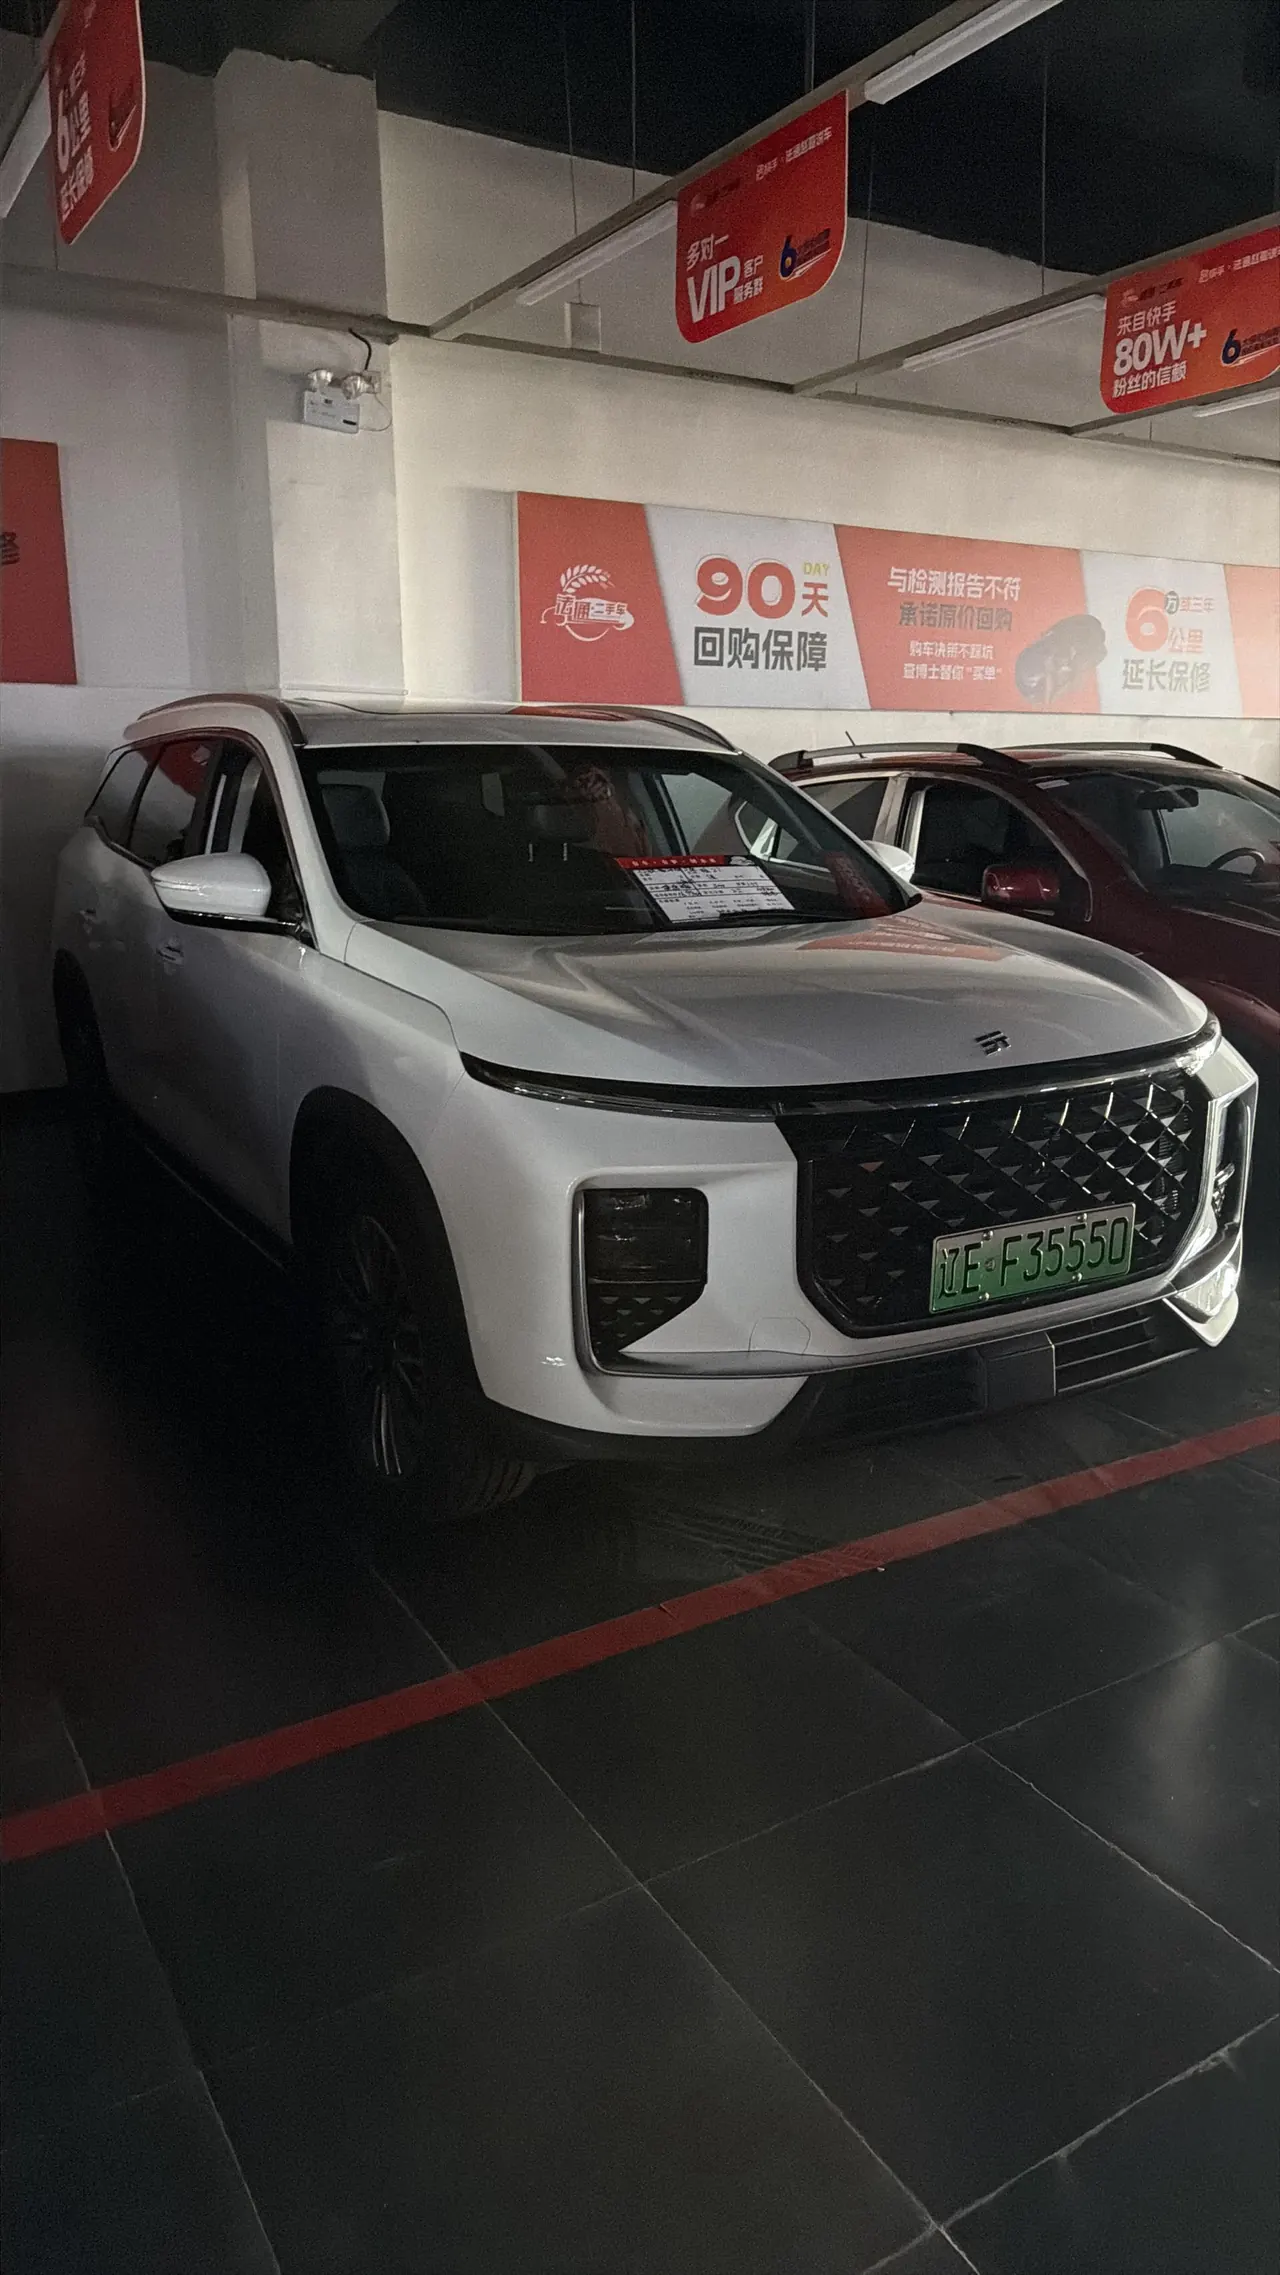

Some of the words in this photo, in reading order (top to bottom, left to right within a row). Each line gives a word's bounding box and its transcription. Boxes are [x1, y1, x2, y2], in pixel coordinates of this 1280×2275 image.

[686, 234, 730, 272] 多对一
[744, 255, 764, 279] 客户
[687, 255, 742, 324] VIP
[733, 276, 764, 304] 服务群
[1116, 300, 1177, 337] 来自快手
[1113, 319, 1207, 377] 80W+
[1112, 360, 1187, 399] 粉丝的信赖
[695, 554, 797, 620] 90
[802, 561, 831, 577] DAY
[888, 566, 1022, 602] 与检测报告不符
[801, 581, 830, 618] 天
[898, 601, 1013, 632] 承诺原价回购
[1125, 586, 1169, 652] 6
[693, 626, 828, 673] 回购保障
[1121, 658, 1212, 693] 延长保修
